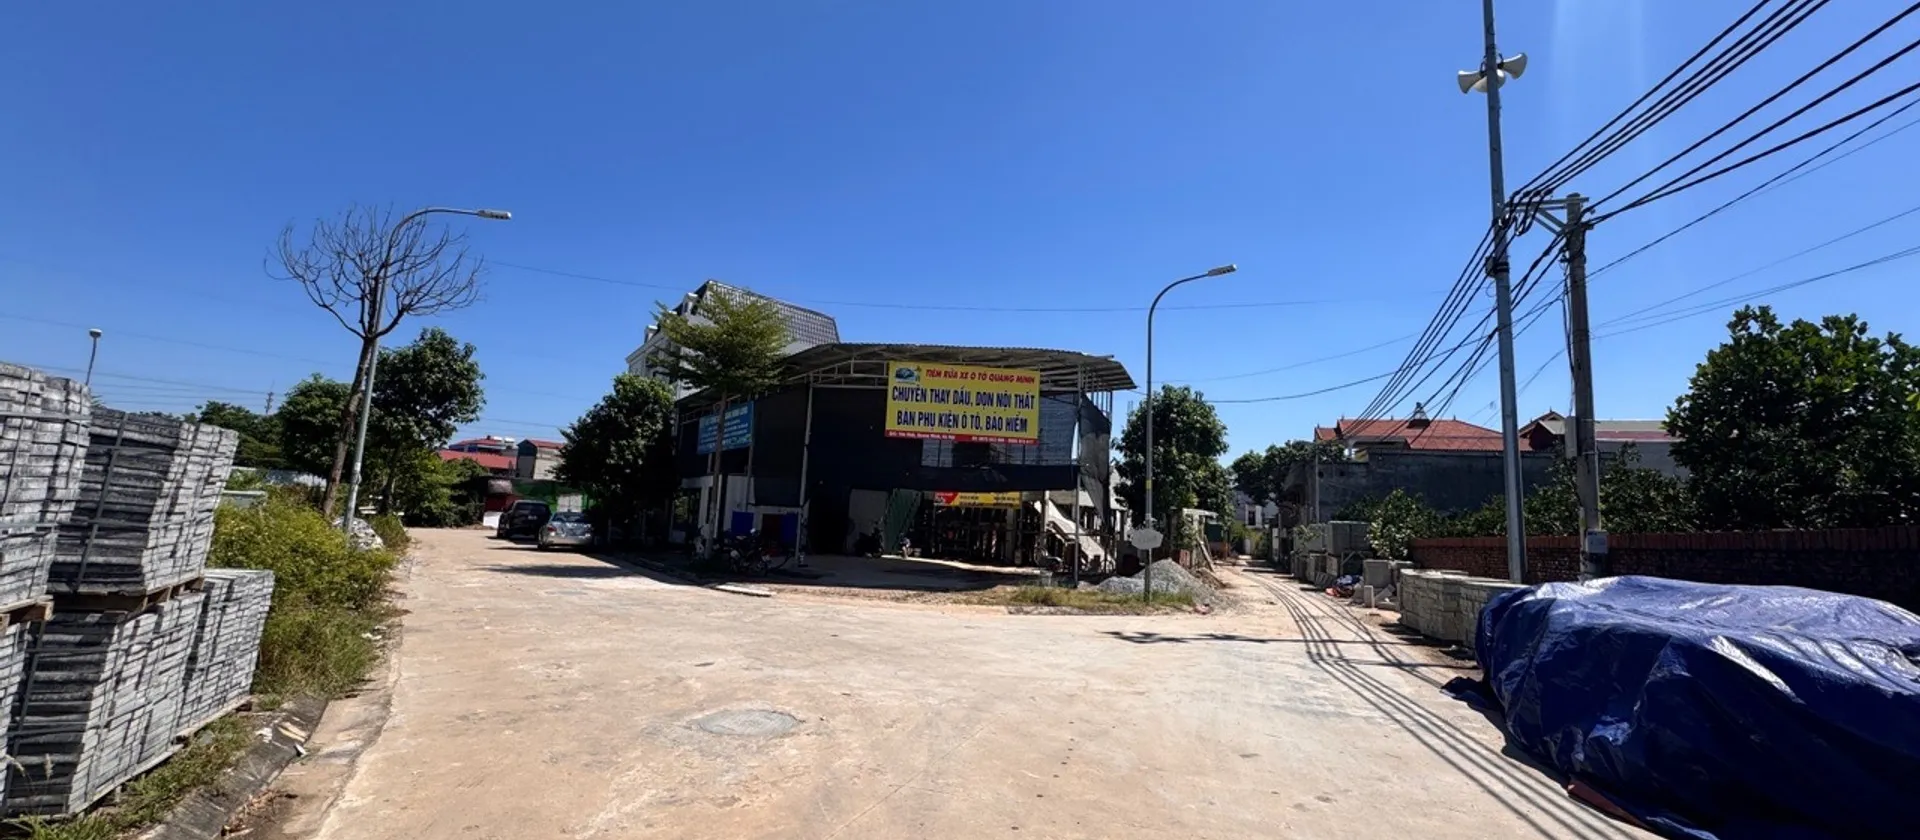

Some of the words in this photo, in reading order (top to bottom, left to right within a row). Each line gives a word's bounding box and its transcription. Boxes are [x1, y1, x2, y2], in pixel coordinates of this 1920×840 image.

[960, 371, 969, 380] XE
[989, 373, 1014, 383] QUANG
[1016, 375, 1035, 384] MINH
[892, 384, 927, 402] CHUYÊN
[930, 389, 950, 404] THAY
[975, 391, 994, 410] DỌN
[996, 390, 1011, 411] NỘI
[918, 411, 936, 431] PHỤ
[938, 410, 960, 432] KIỆN
[961, 411, 968, 429] Ô
[985, 411, 1003, 431] BẢO
[1005, 411, 1028, 433] HIỂM
